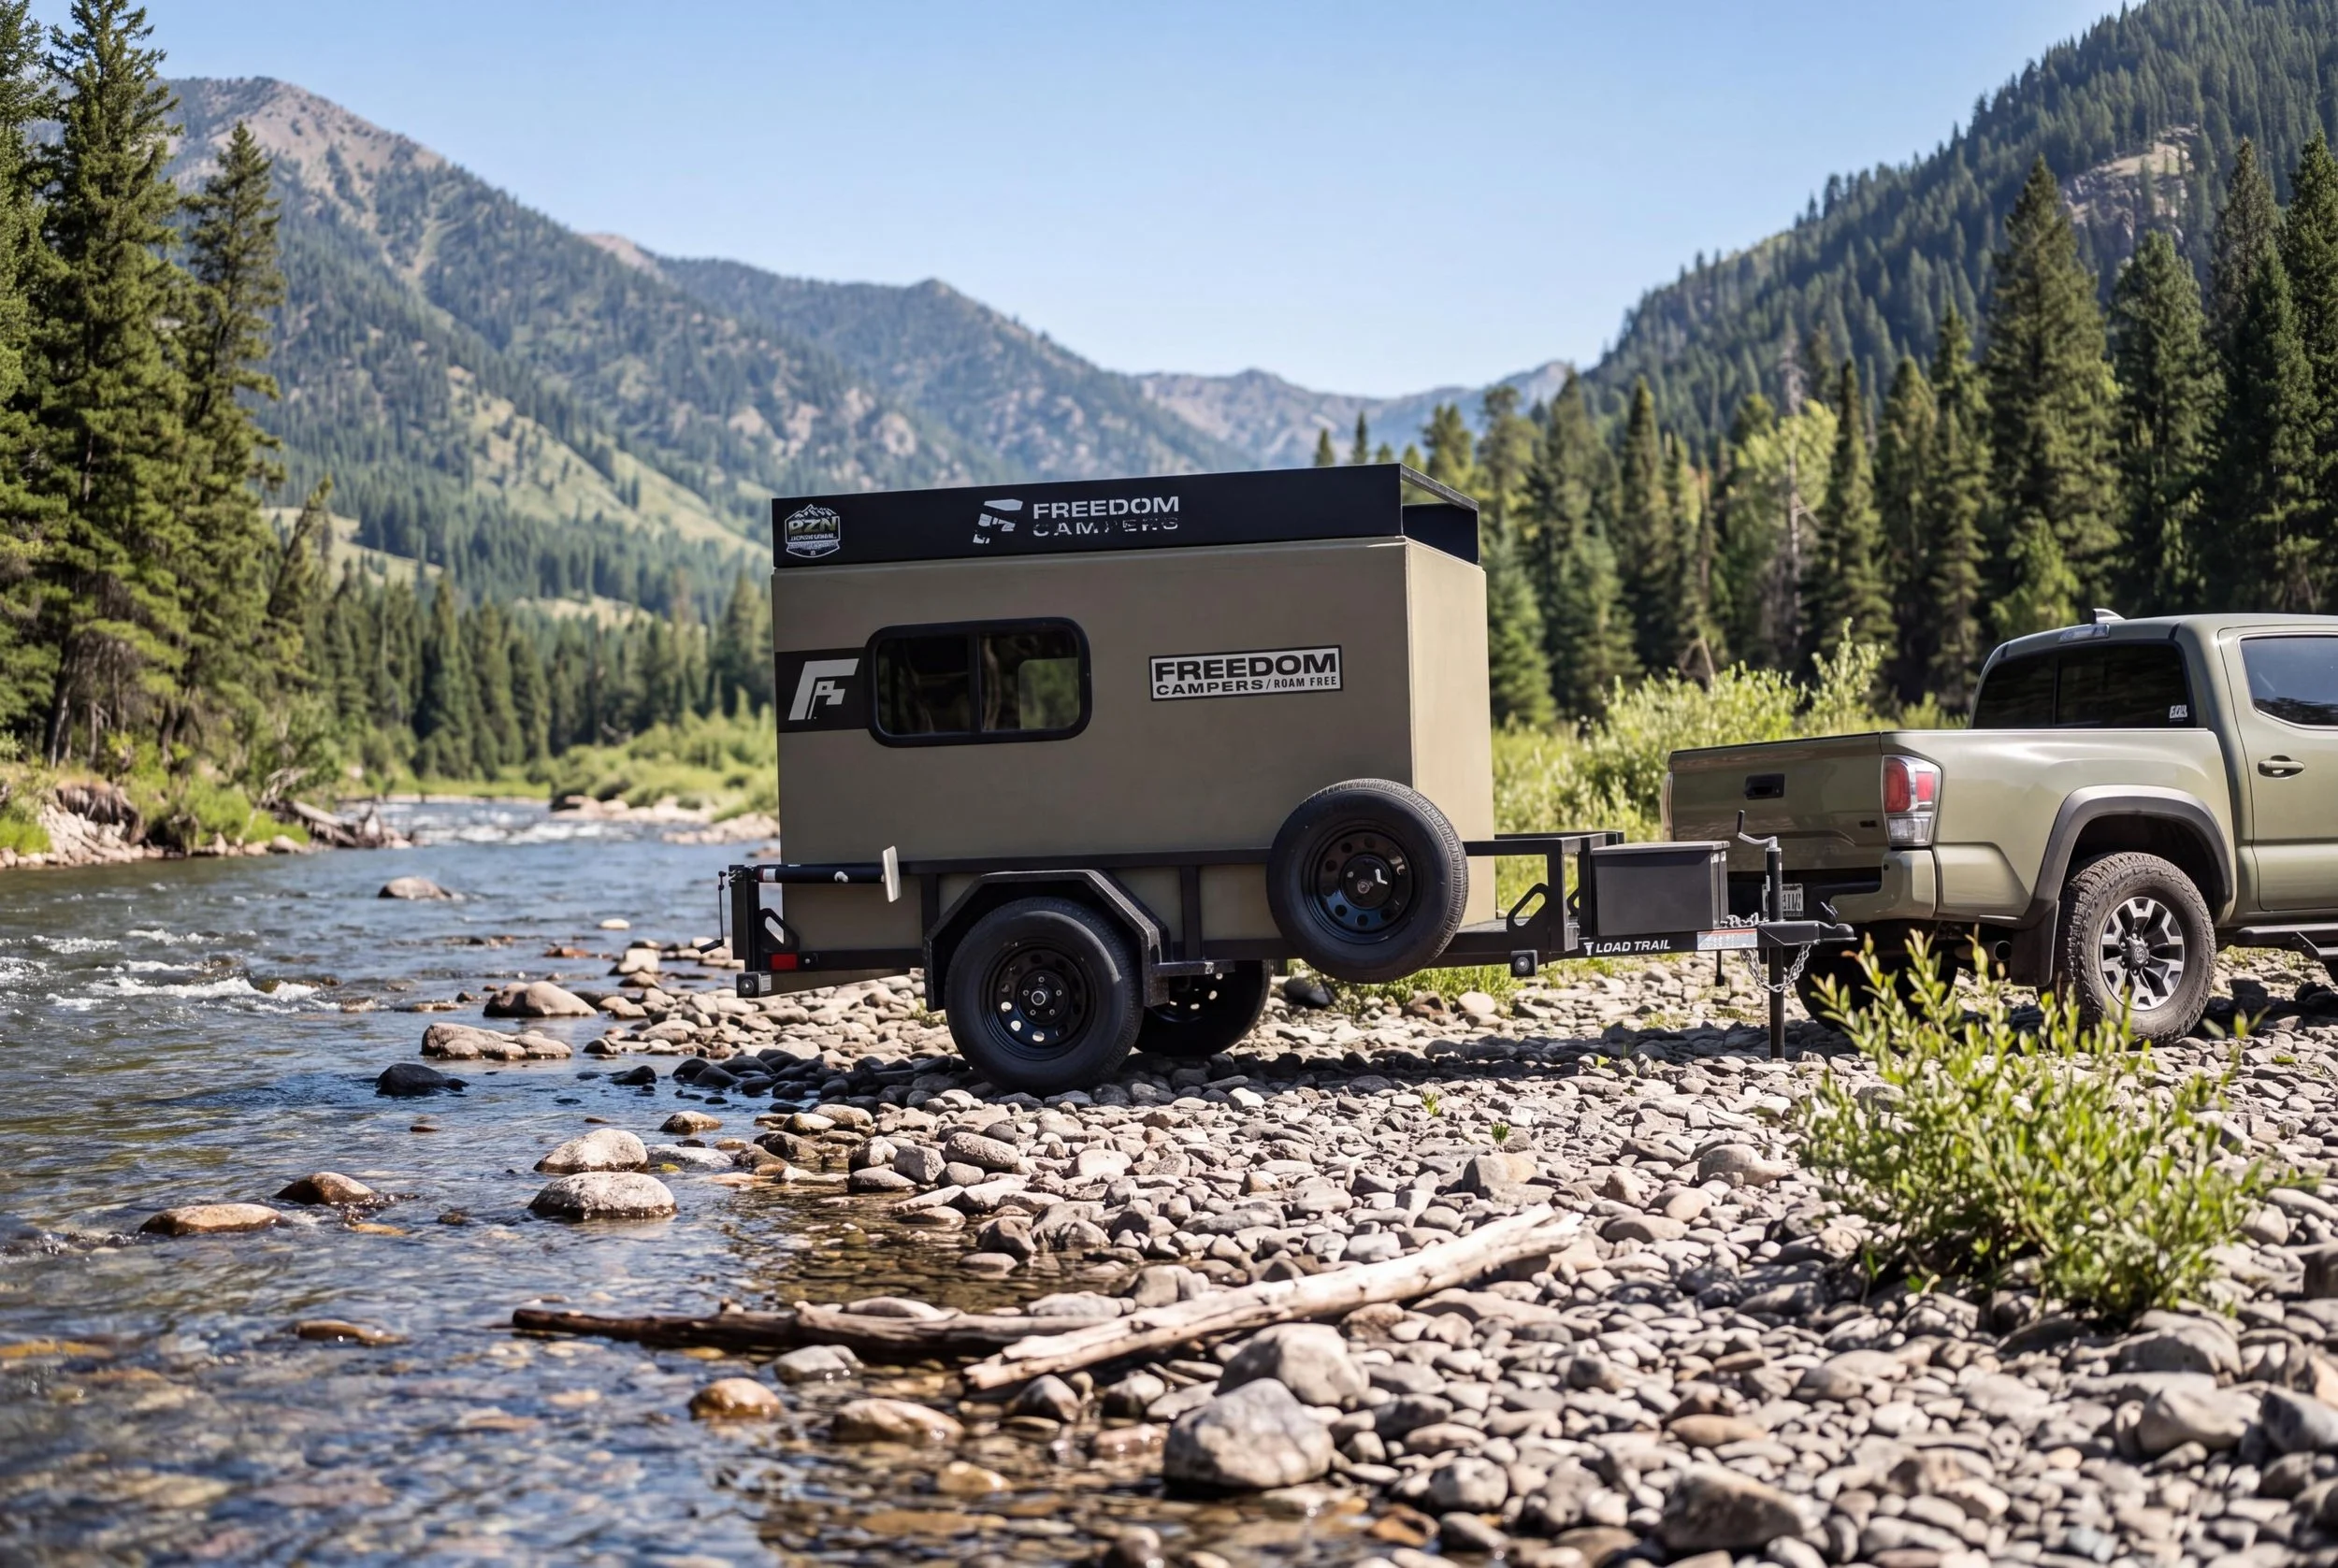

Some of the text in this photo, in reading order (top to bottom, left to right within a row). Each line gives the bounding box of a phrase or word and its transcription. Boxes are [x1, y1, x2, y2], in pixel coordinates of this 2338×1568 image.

[1033, 496, 1179, 519] FREEDOM
[1155, 653, 1336, 683] FREEDOM
[1310, 676, 1337, 686] FREE
[1595, 939, 1671, 954] LOAD TRAIL
